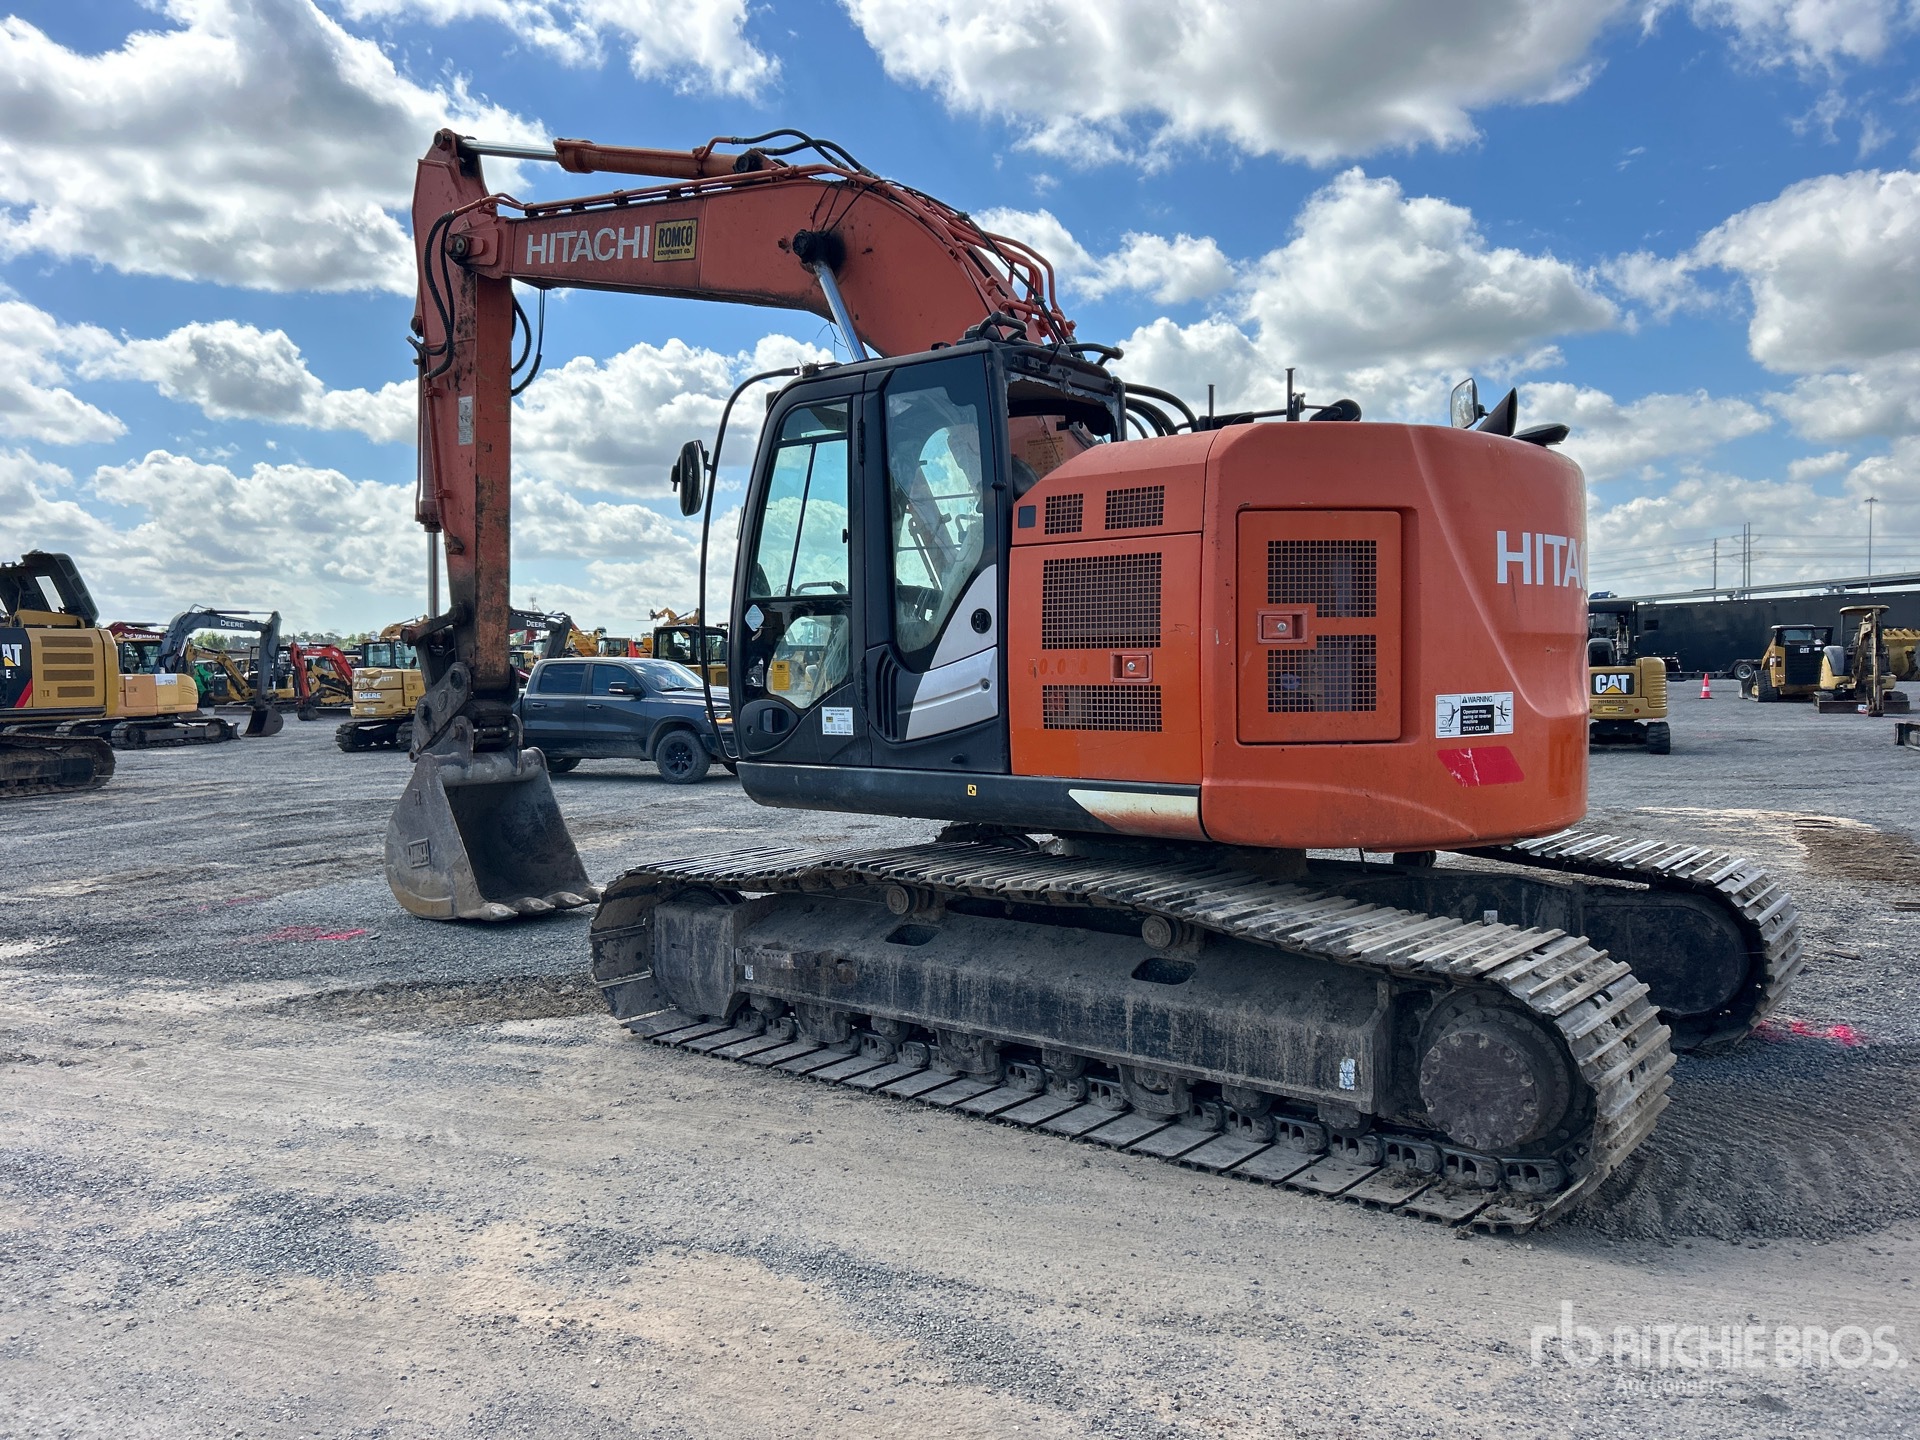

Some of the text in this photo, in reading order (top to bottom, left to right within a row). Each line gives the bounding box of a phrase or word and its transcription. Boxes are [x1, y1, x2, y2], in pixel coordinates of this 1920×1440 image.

[526, 225, 651, 265] HITACHI
[658, 225, 693, 249] ROMCO
[220, 619, 244, 629] DEERE
[526, 620, 547, 629] DEERE
[1, 643, 23, 667] AT
[1595, 674, 1630, 694] CAT
[1467, 695, 1493, 704] WARNING
